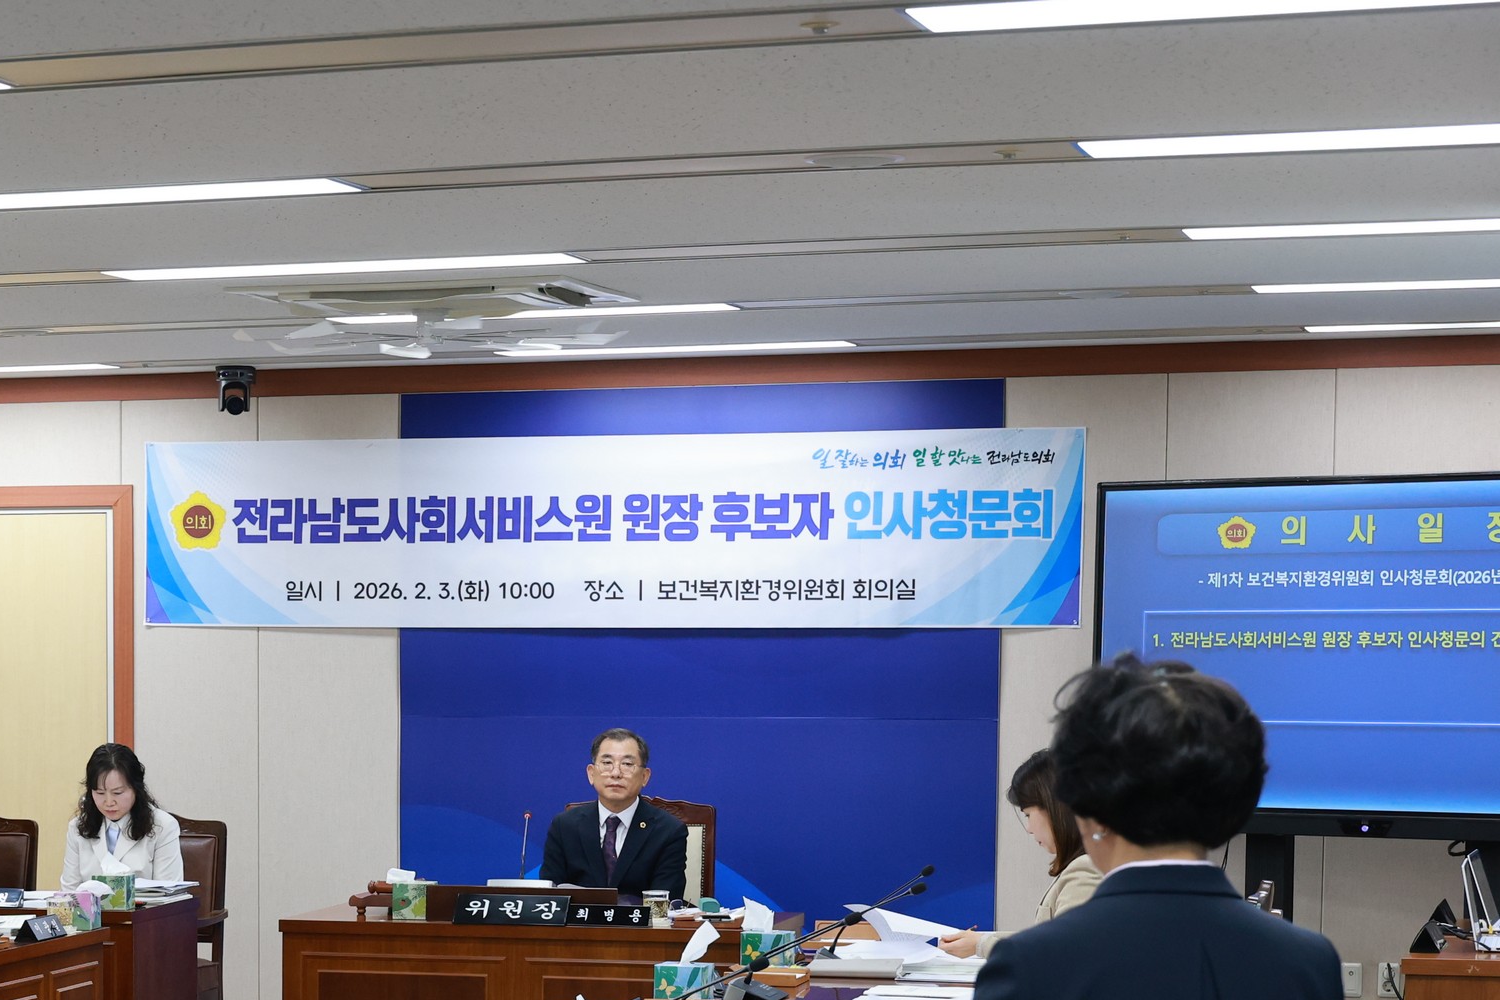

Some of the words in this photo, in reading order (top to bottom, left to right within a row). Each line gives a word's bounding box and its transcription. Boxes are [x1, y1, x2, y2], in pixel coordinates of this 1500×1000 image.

[872, 449, 906, 470] 의회
[987, 448, 1056, 466] 전라남도의회
[183, 514, 212, 530] 의회
[232, 494, 612, 545] 전라남도사회서비스원
[623, 494, 703, 542] 원장
[711, 491, 834, 541] 후보자
[844, 488, 1054, 540] 인사청문회
[1226, 528, 1247, 539] 의회
[1207, 572, 1243, 588] 제1차
[1247, 569, 1374, 588] 보건복지환경위원회
[286, 580, 322, 602] 일시
[354, 582, 407, 600] 2026.
[414, 582, 431, 600] 2.
[438, 580, 490, 602] 3.(화)
[499, 582, 555, 600] 10:00
[584, 579, 624, 602] 장소
[657, 578, 844, 601] 보건복지환경위원회
[852, 578, 916, 601] 회의실
[1152, 633, 1164, 648] 1.
[1170, 631, 1317, 649] 전라남도사회서비스원
[1322, 631, 1351, 649] 원장
[1356, 630, 1403, 648] 후보자
[1407, 630, 1485, 649] 인사청문의
[465, 899, 561, 920] 위원장
[575, 908, 642, 923] 최병용
